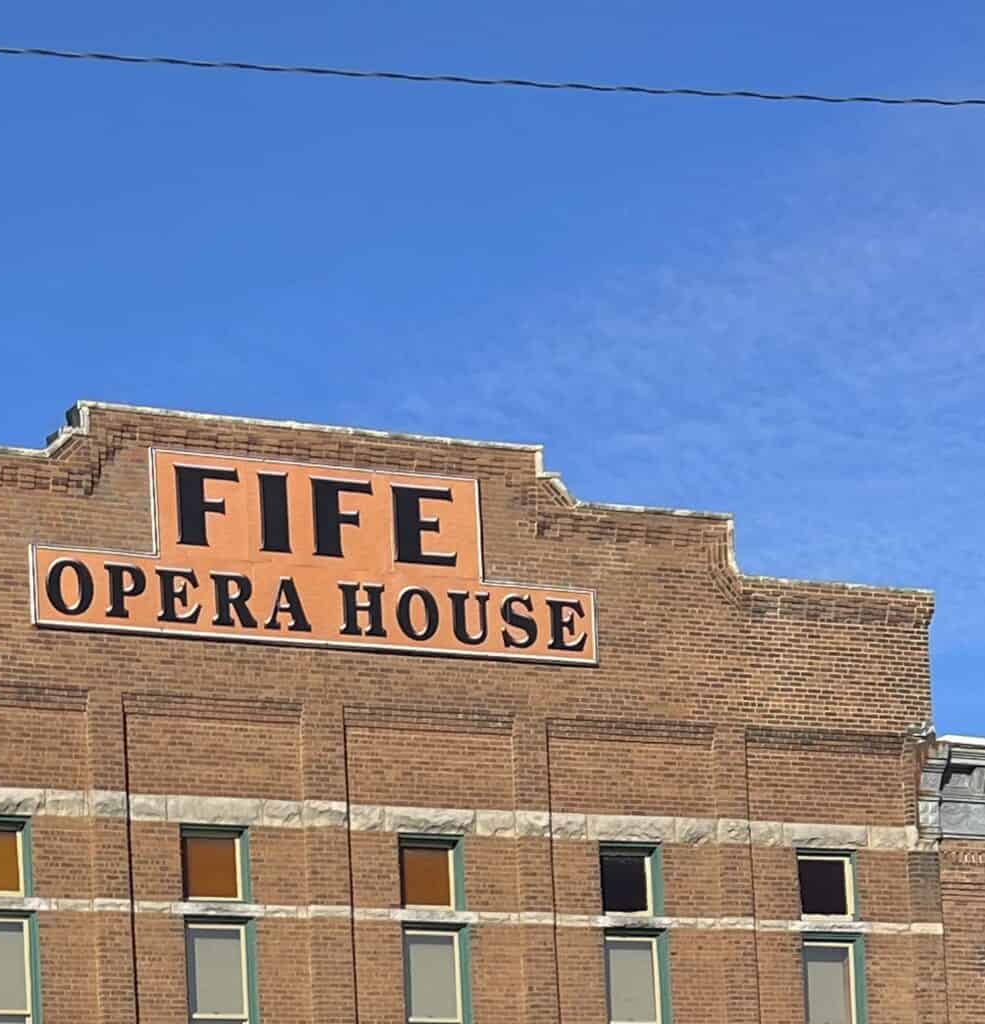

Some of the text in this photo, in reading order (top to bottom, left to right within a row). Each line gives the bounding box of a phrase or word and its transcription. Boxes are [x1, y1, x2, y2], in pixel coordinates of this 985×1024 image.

[173, 464, 457, 568] FIFE
[45, 558, 589, 652] OPERA HOUSE
